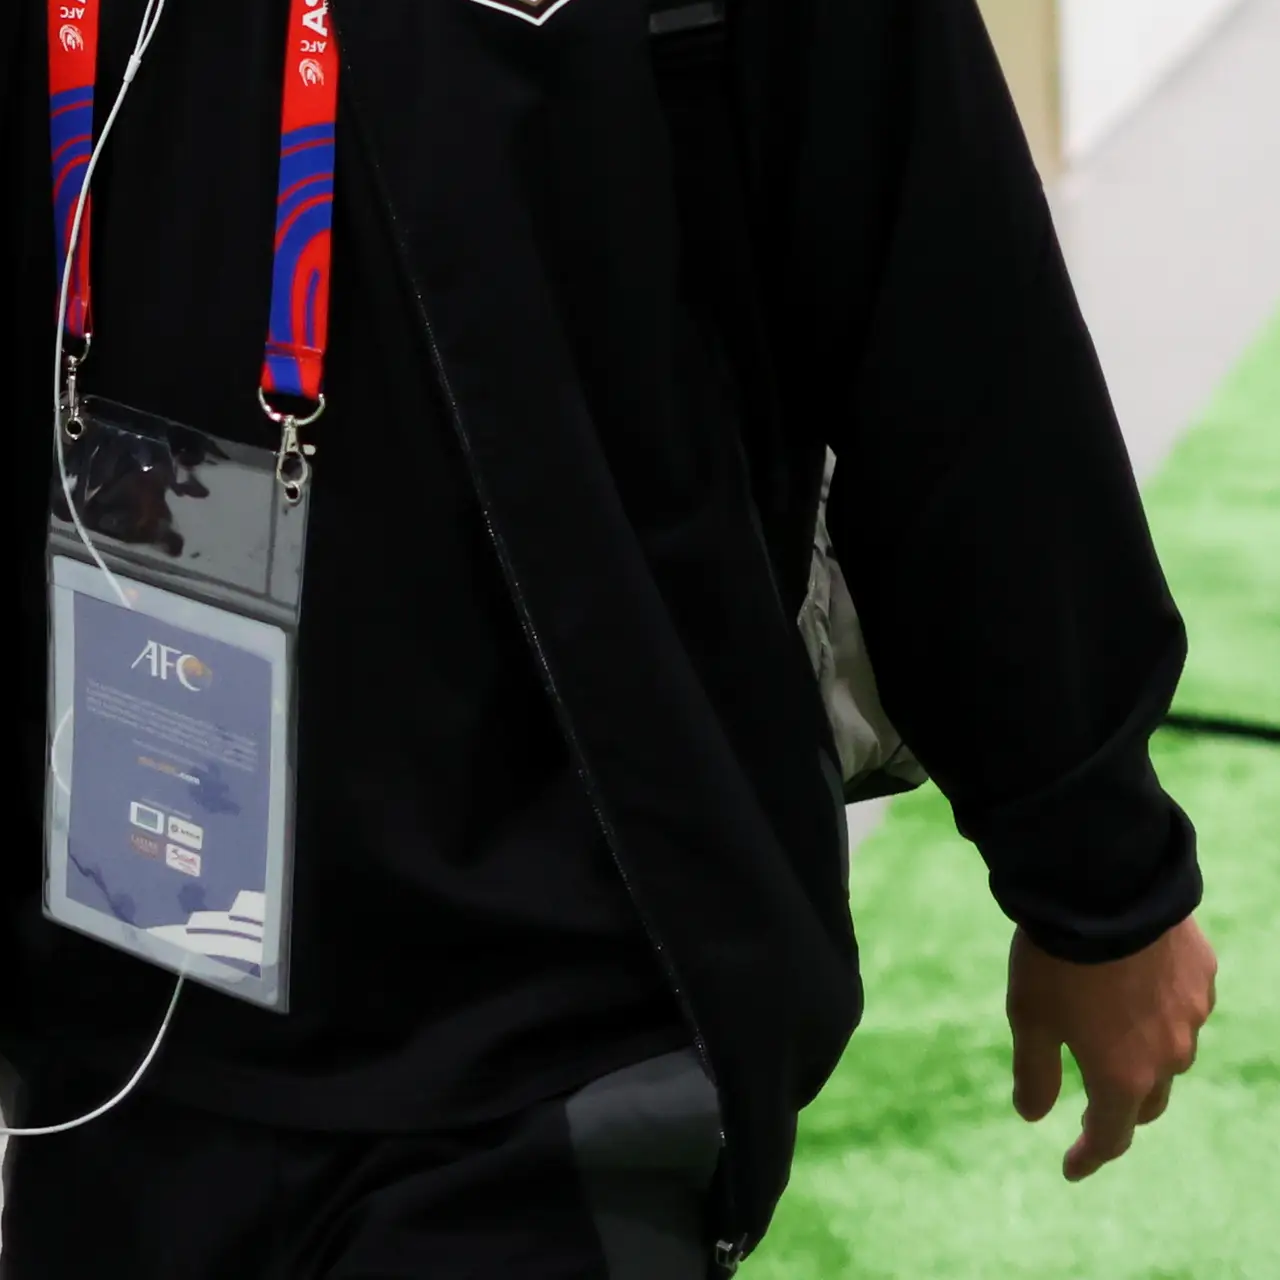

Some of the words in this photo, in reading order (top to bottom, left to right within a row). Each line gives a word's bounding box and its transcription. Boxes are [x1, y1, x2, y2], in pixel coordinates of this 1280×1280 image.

[60, 7, 85, 19] AFC
[300, 40, 327, 53] AFC
[131, 639, 203, 692] AFC
